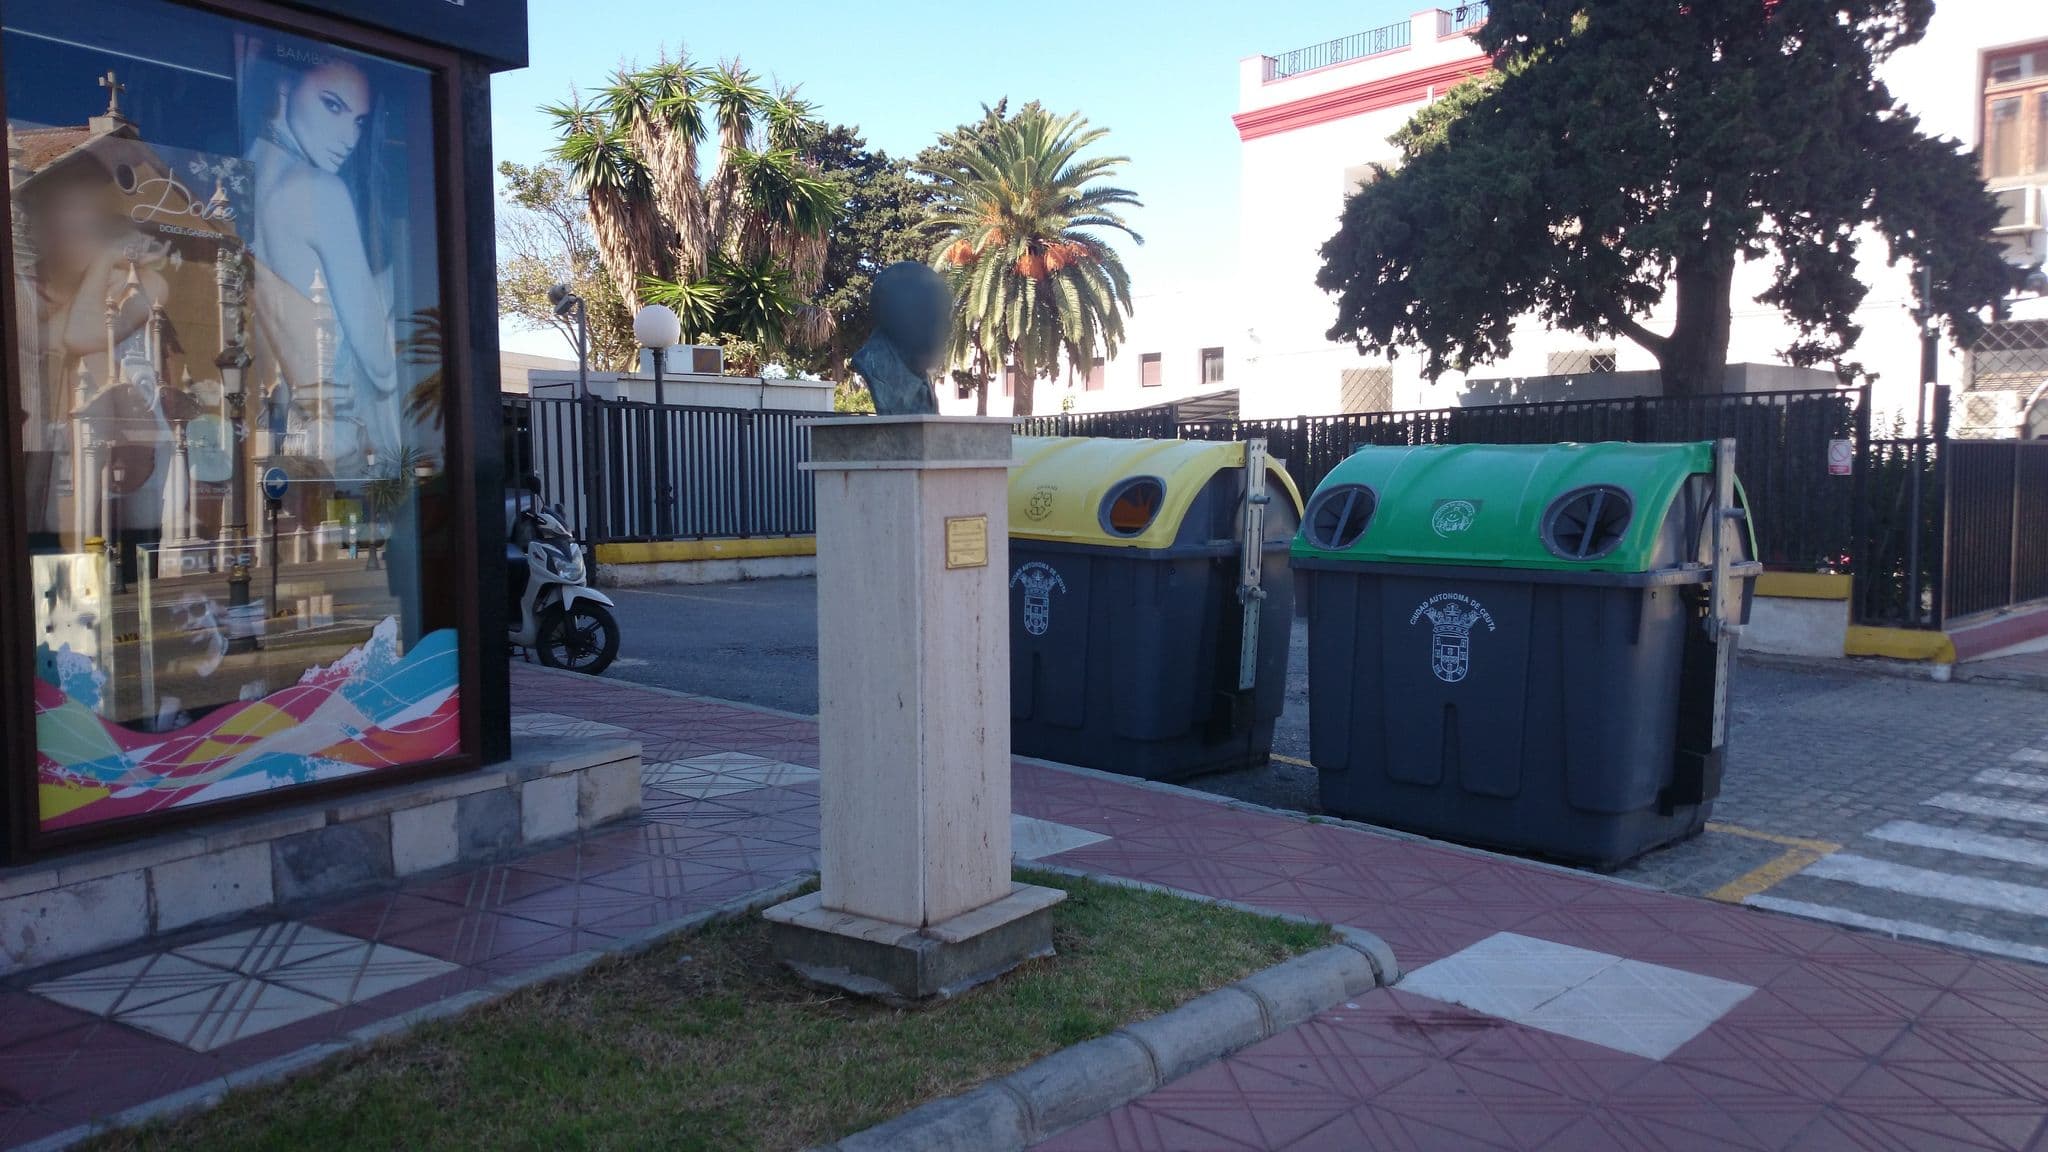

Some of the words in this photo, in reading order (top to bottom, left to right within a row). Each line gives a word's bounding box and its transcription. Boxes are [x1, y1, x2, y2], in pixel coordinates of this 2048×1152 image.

[131, 168, 238, 224] Dolce
[1410, 601, 1429, 625] CIUDAD
[1429, 592, 1469, 604] AUTONOMA
[1470, 599, 1481, 610] DE
[1479, 608, 1496, 632] CEUTA
